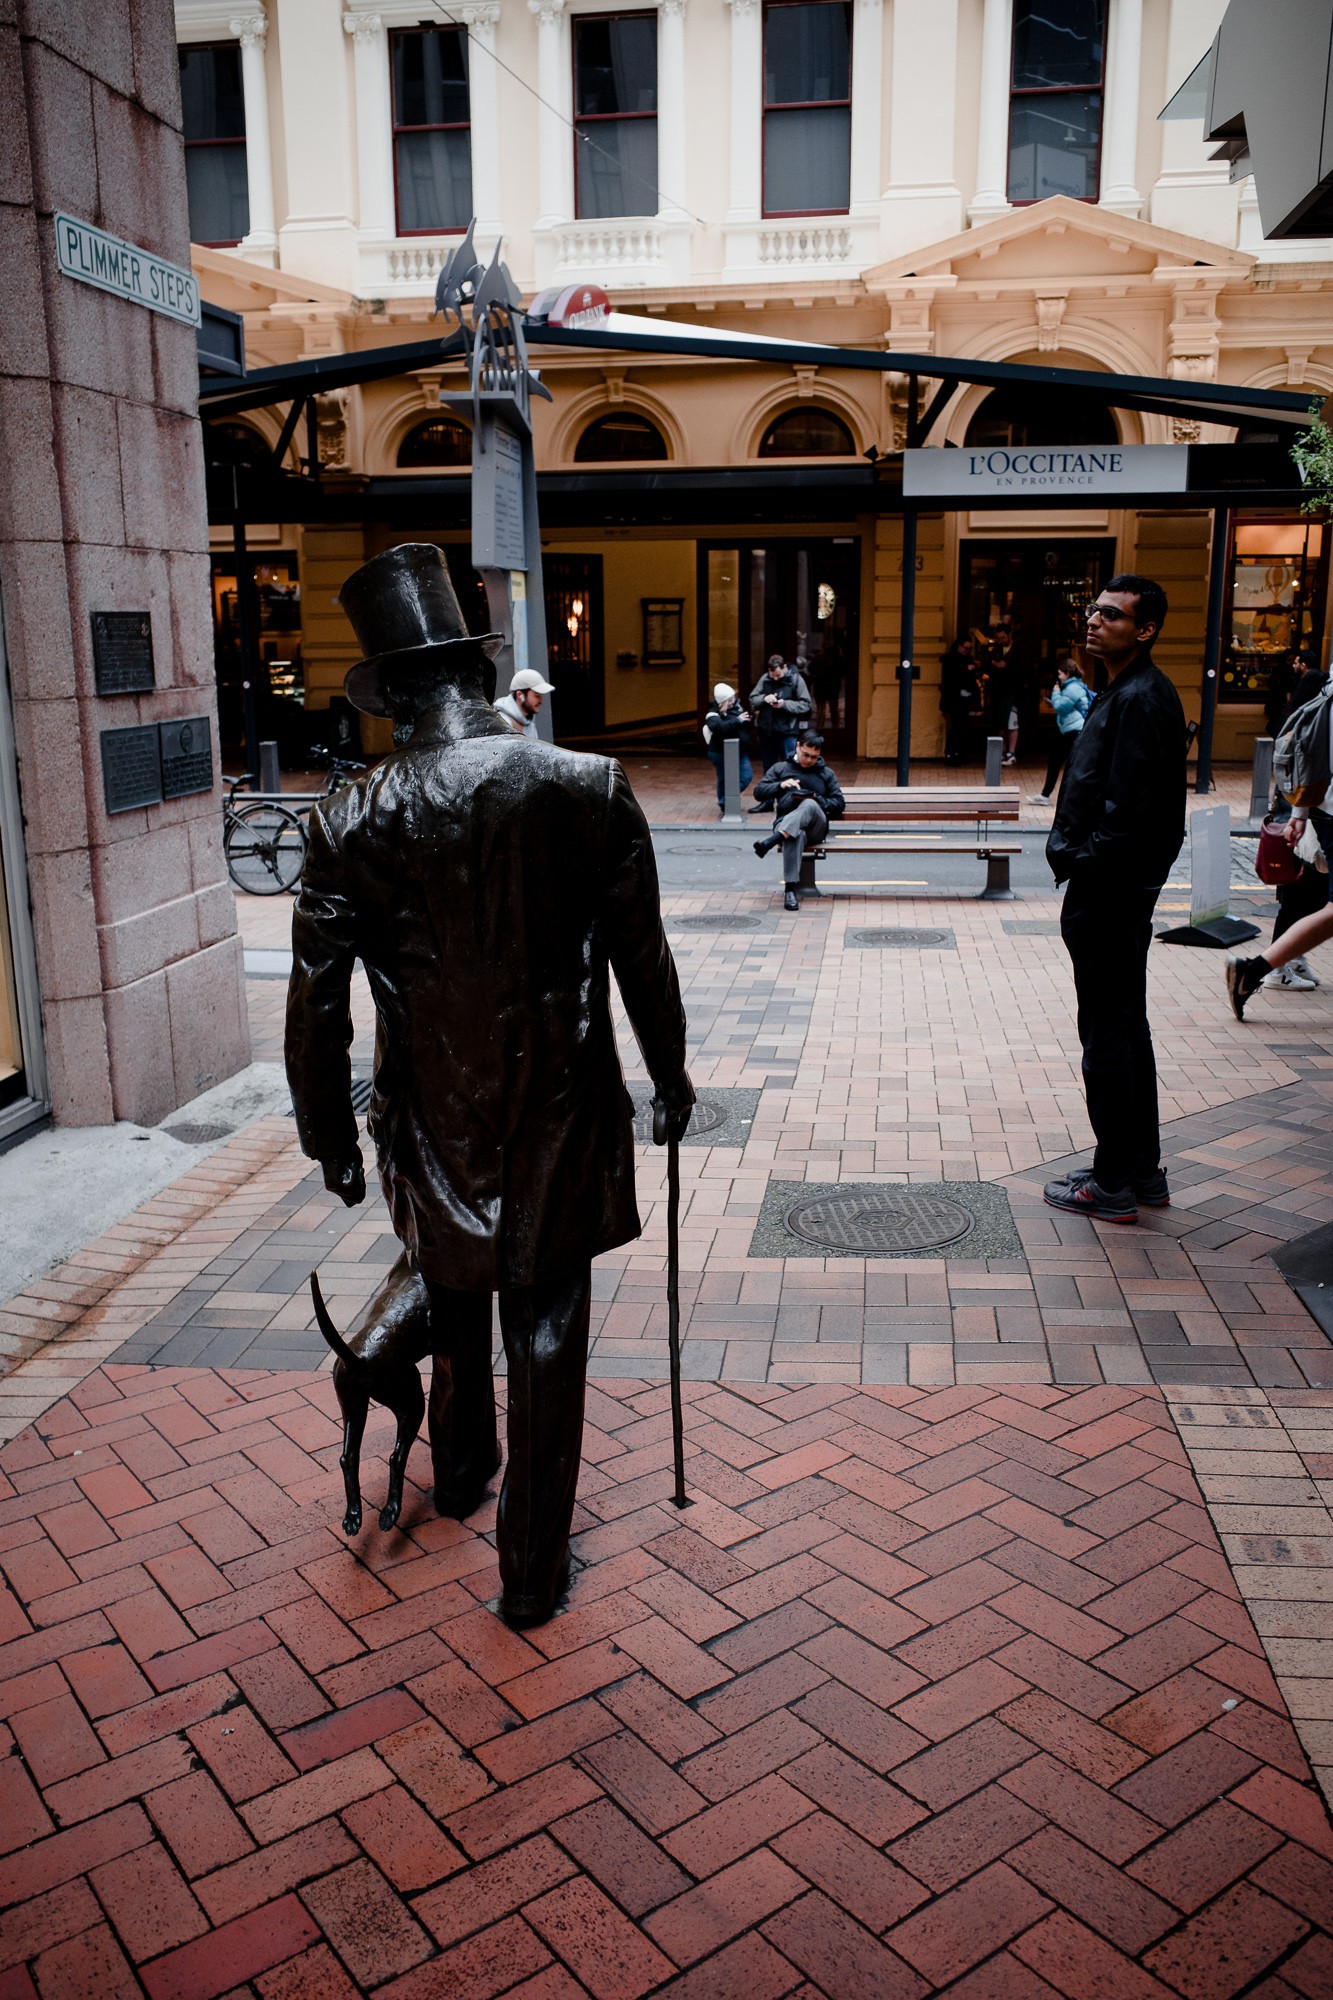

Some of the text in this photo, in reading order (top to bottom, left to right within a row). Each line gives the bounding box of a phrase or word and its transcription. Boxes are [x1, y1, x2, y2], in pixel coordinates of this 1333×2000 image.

[66, 226, 194, 315] PLIMMER STEPS
[969, 450, 1123, 475] L'OCCITANE
[996, 475, 1094, 486] EN PROVENCE
